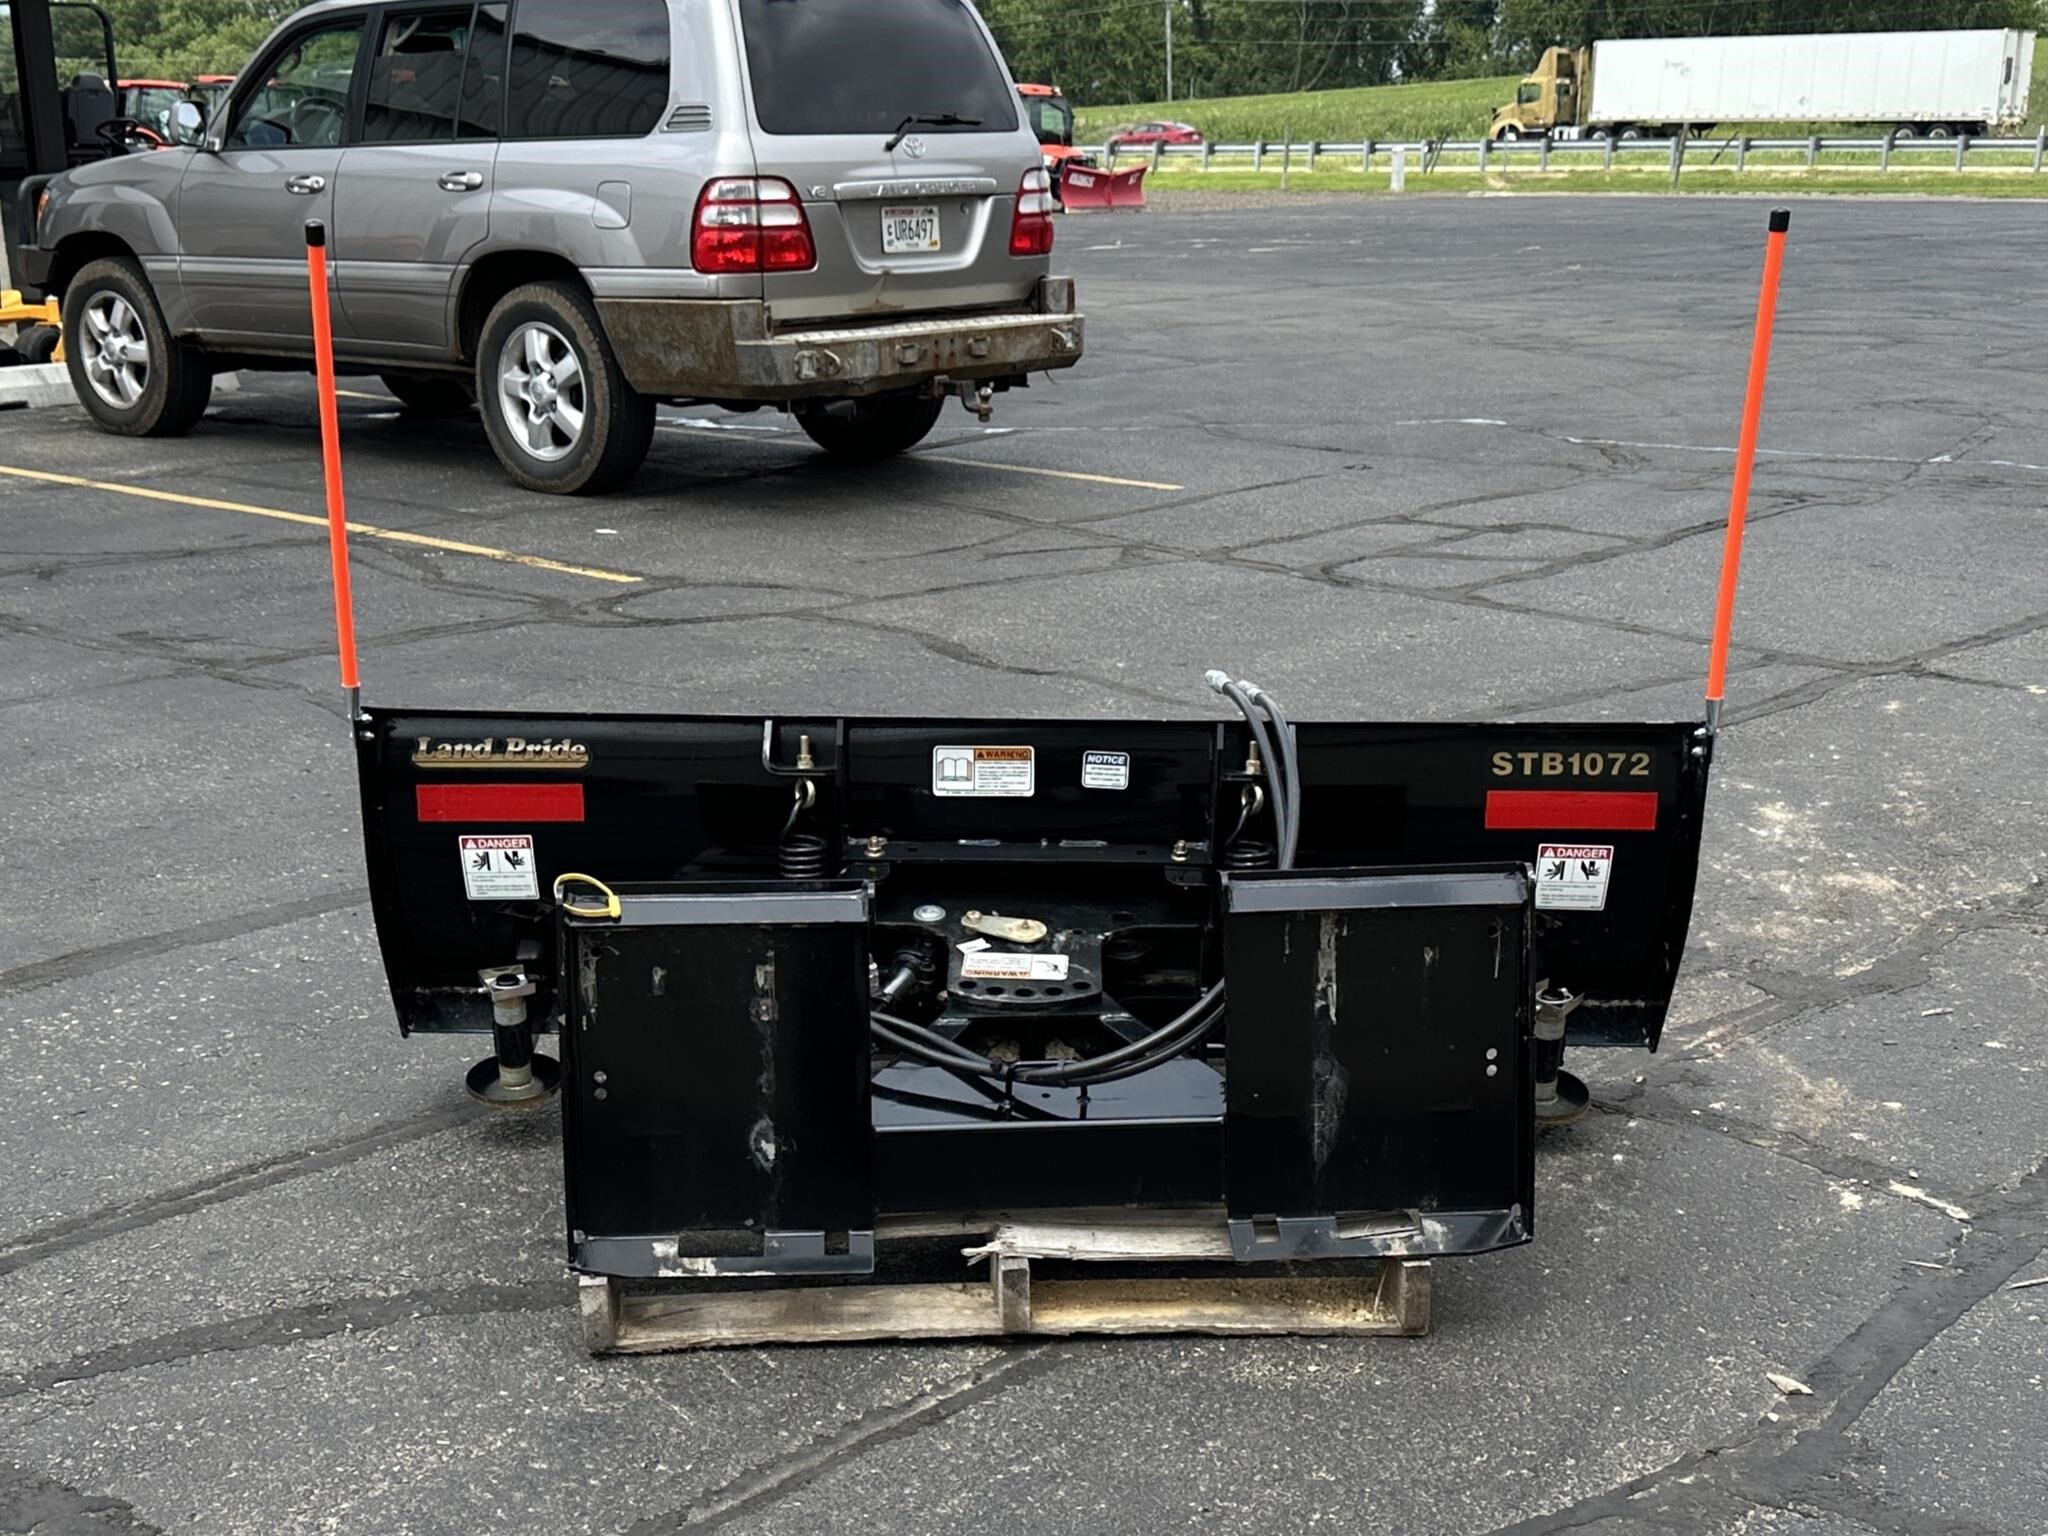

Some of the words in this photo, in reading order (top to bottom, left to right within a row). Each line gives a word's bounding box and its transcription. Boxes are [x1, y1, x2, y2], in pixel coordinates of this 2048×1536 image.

[894, 218, 934, 241] UR6497
[415, 736, 494, 760] Land
[504, 737, 587, 760] Pride
[984, 750, 1029, 759] WARNING
[1087, 754, 1126, 765] NOTICE
[1491, 751, 1650, 776] STB1072
[477, 838, 528, 849] DANGER
[1557, 847, 1608, 858] DANGER
[965, 969, 1018, 978] WARNING
